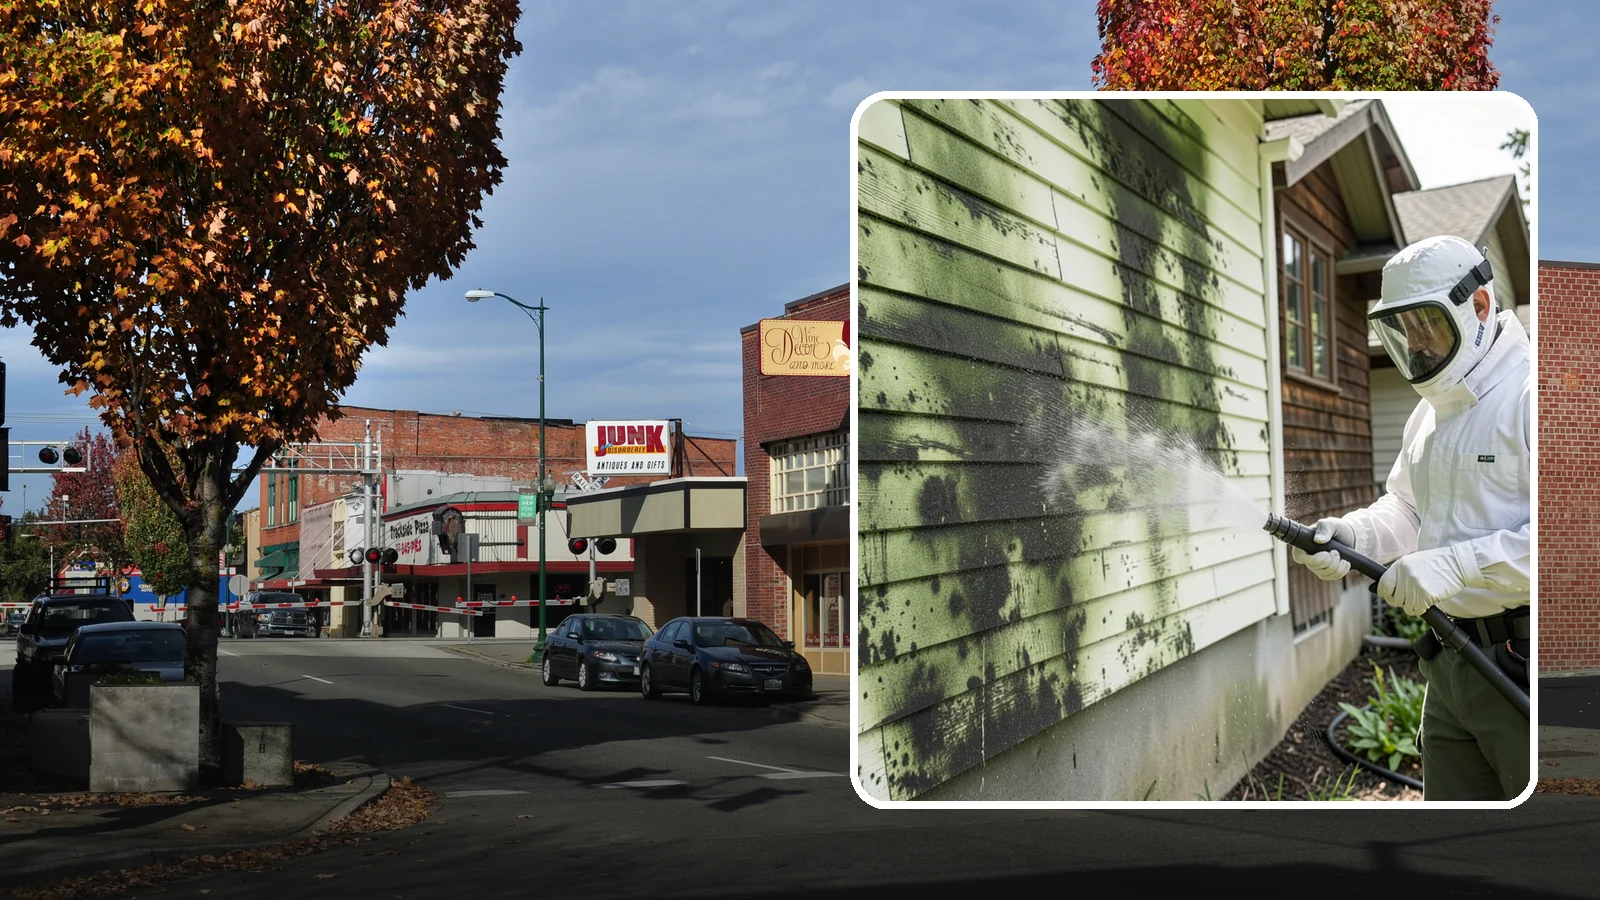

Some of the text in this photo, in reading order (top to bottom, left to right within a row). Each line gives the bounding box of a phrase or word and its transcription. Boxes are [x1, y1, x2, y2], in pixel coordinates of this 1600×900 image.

[595, 425, 665, 457] JUNK
[607, 446, 646, 454] DISORDERLY
[597, 460, 666, 470] ANTIQUES AND GIFTS
[390, 519, 429, 540] Trackside Pizza
